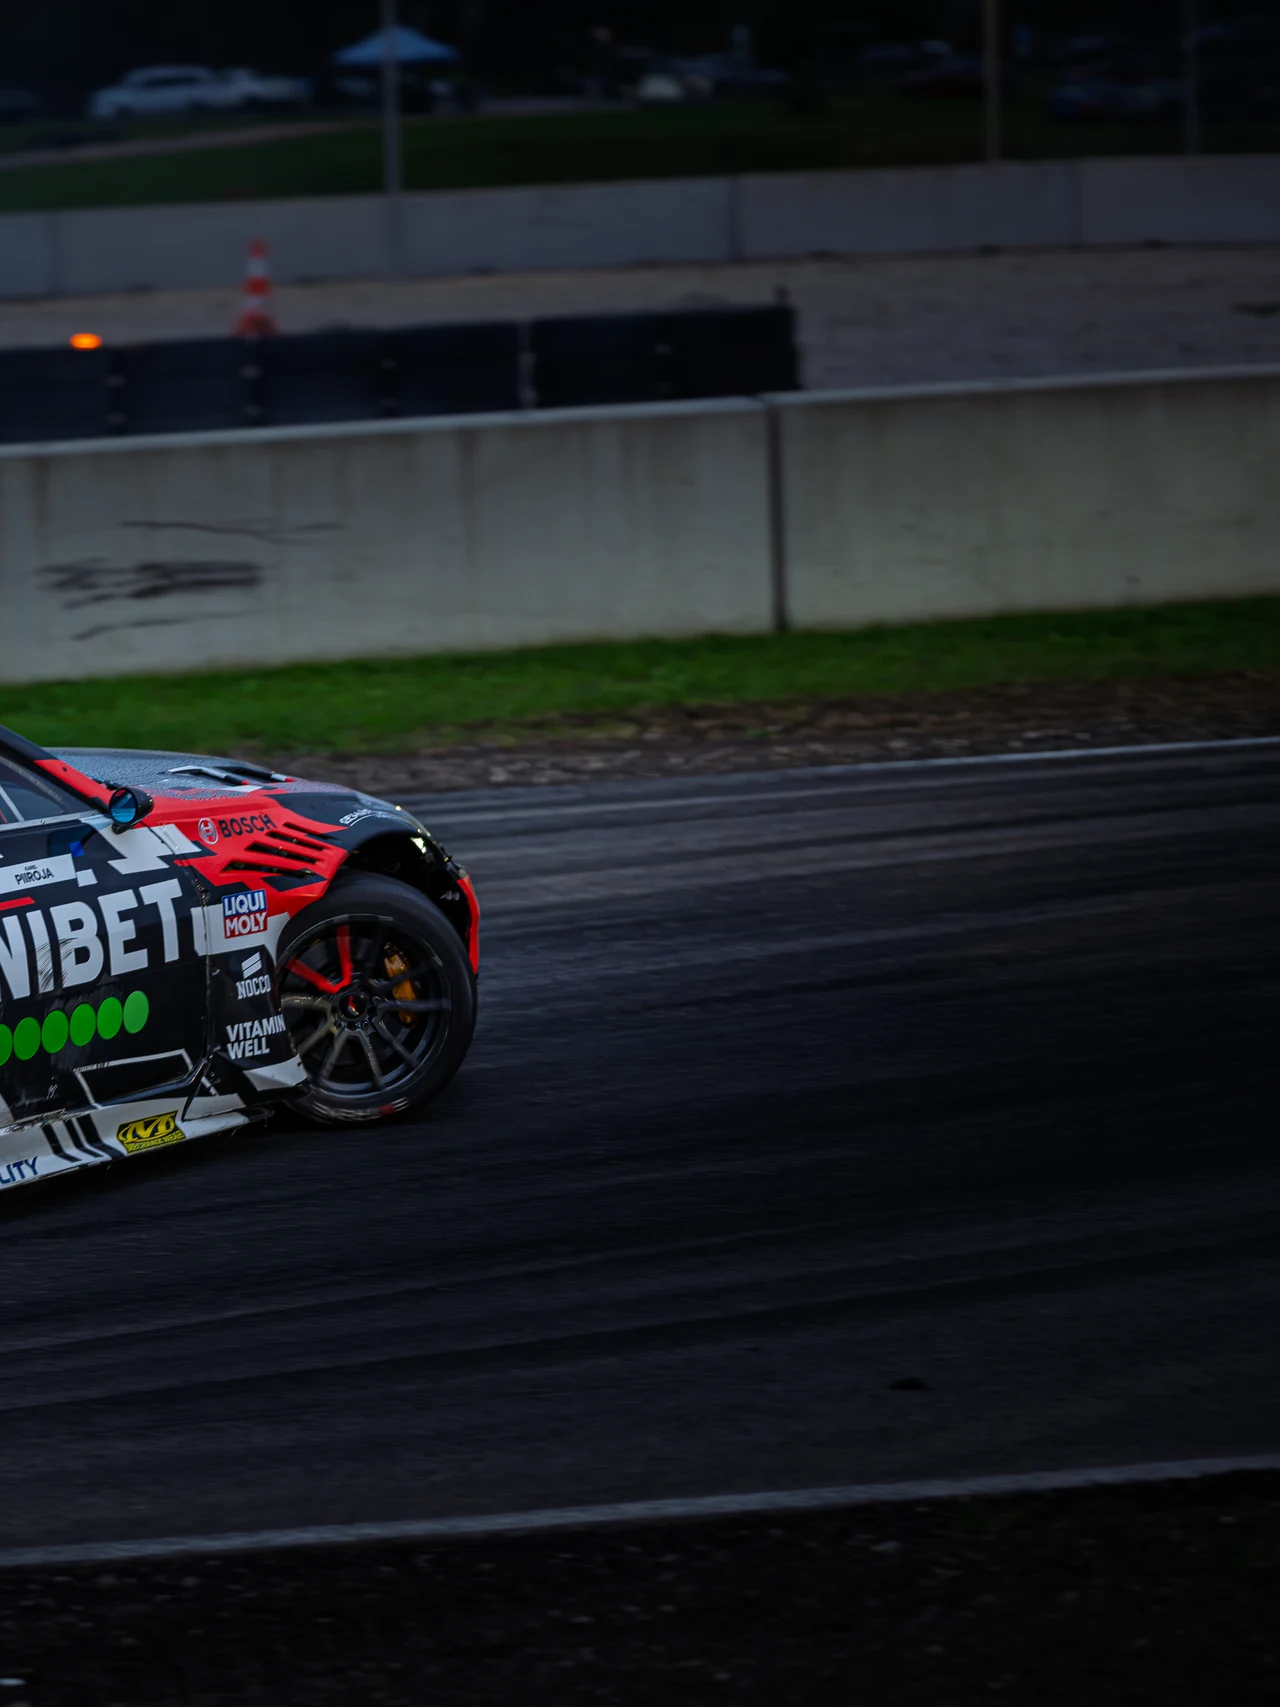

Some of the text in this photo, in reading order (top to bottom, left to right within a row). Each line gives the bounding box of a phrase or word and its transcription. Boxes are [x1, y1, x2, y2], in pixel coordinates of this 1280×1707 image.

[218, 814, 277, 839] BOSCH
[14, 867, 55, 885] PIIROJA
[224, 890, 265, 916] LIQUI
[225, 911, 268, 938] MOLY
[236, 974, 271, 1000] NOCCO
[225, 1013, 287, 1042] VITAMIN
[227, 1036, 271, 1060] WELL
